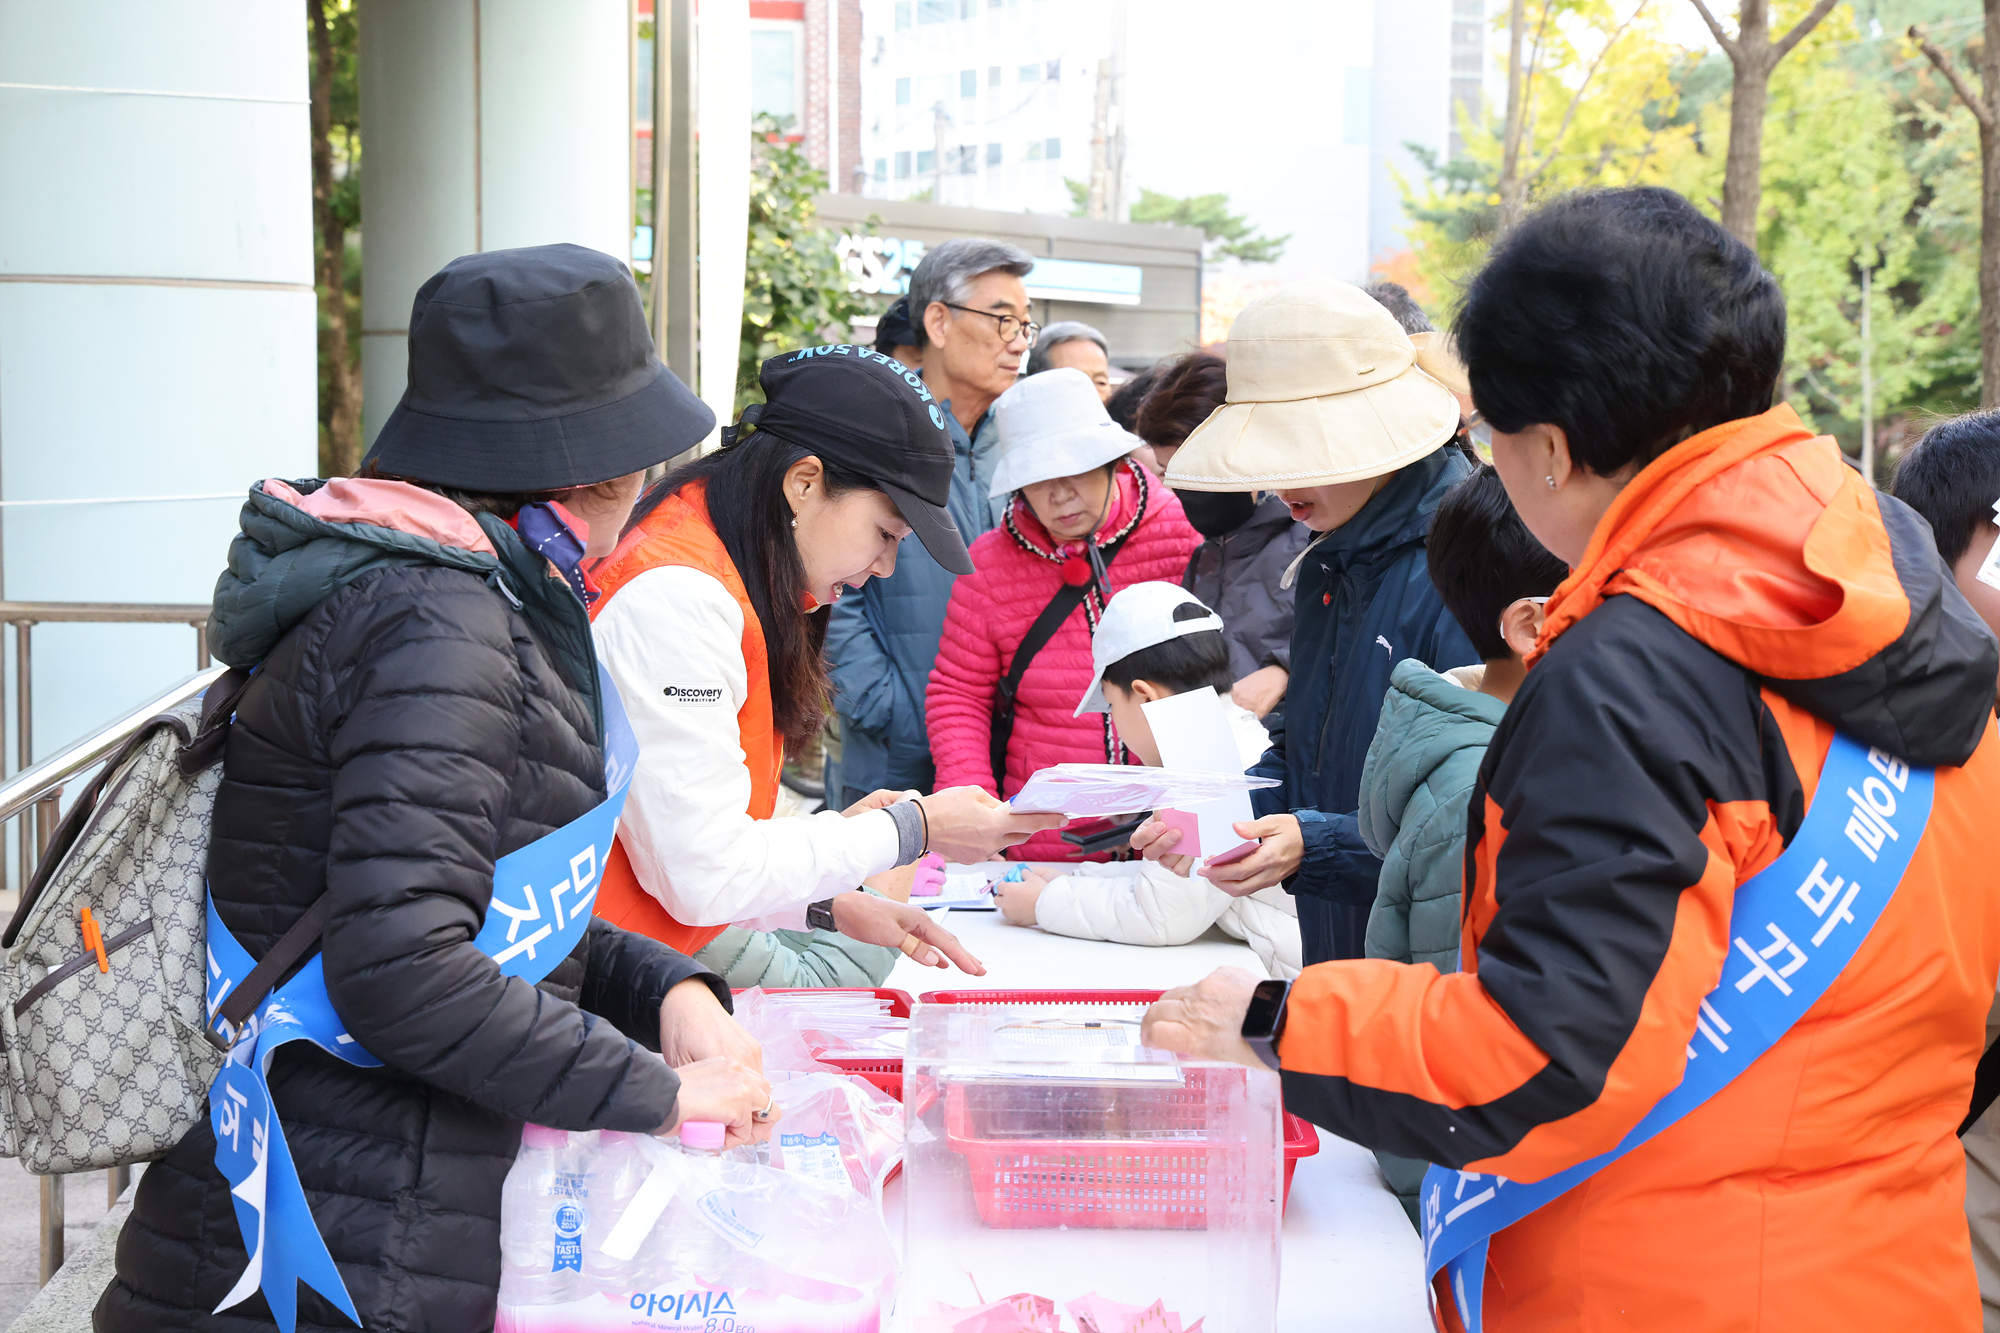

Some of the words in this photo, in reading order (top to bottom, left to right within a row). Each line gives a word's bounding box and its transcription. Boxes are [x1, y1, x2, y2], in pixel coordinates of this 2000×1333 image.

[857, 346, 933, 402] KOREA
[665, 686, 723, 700] Discovery
[555, 1245, 582, 1255] TASTE
[630, 1291, 737, 1321] 아이시스
[631, 1320, 656, 1329] Natural
[658, 1323, 682, 1332] Mineral
[683, 1324, 704, 1332] Water
[704, 1317, 736, 1333] 8.0
[736, 1324, 756, 1333] ECO
